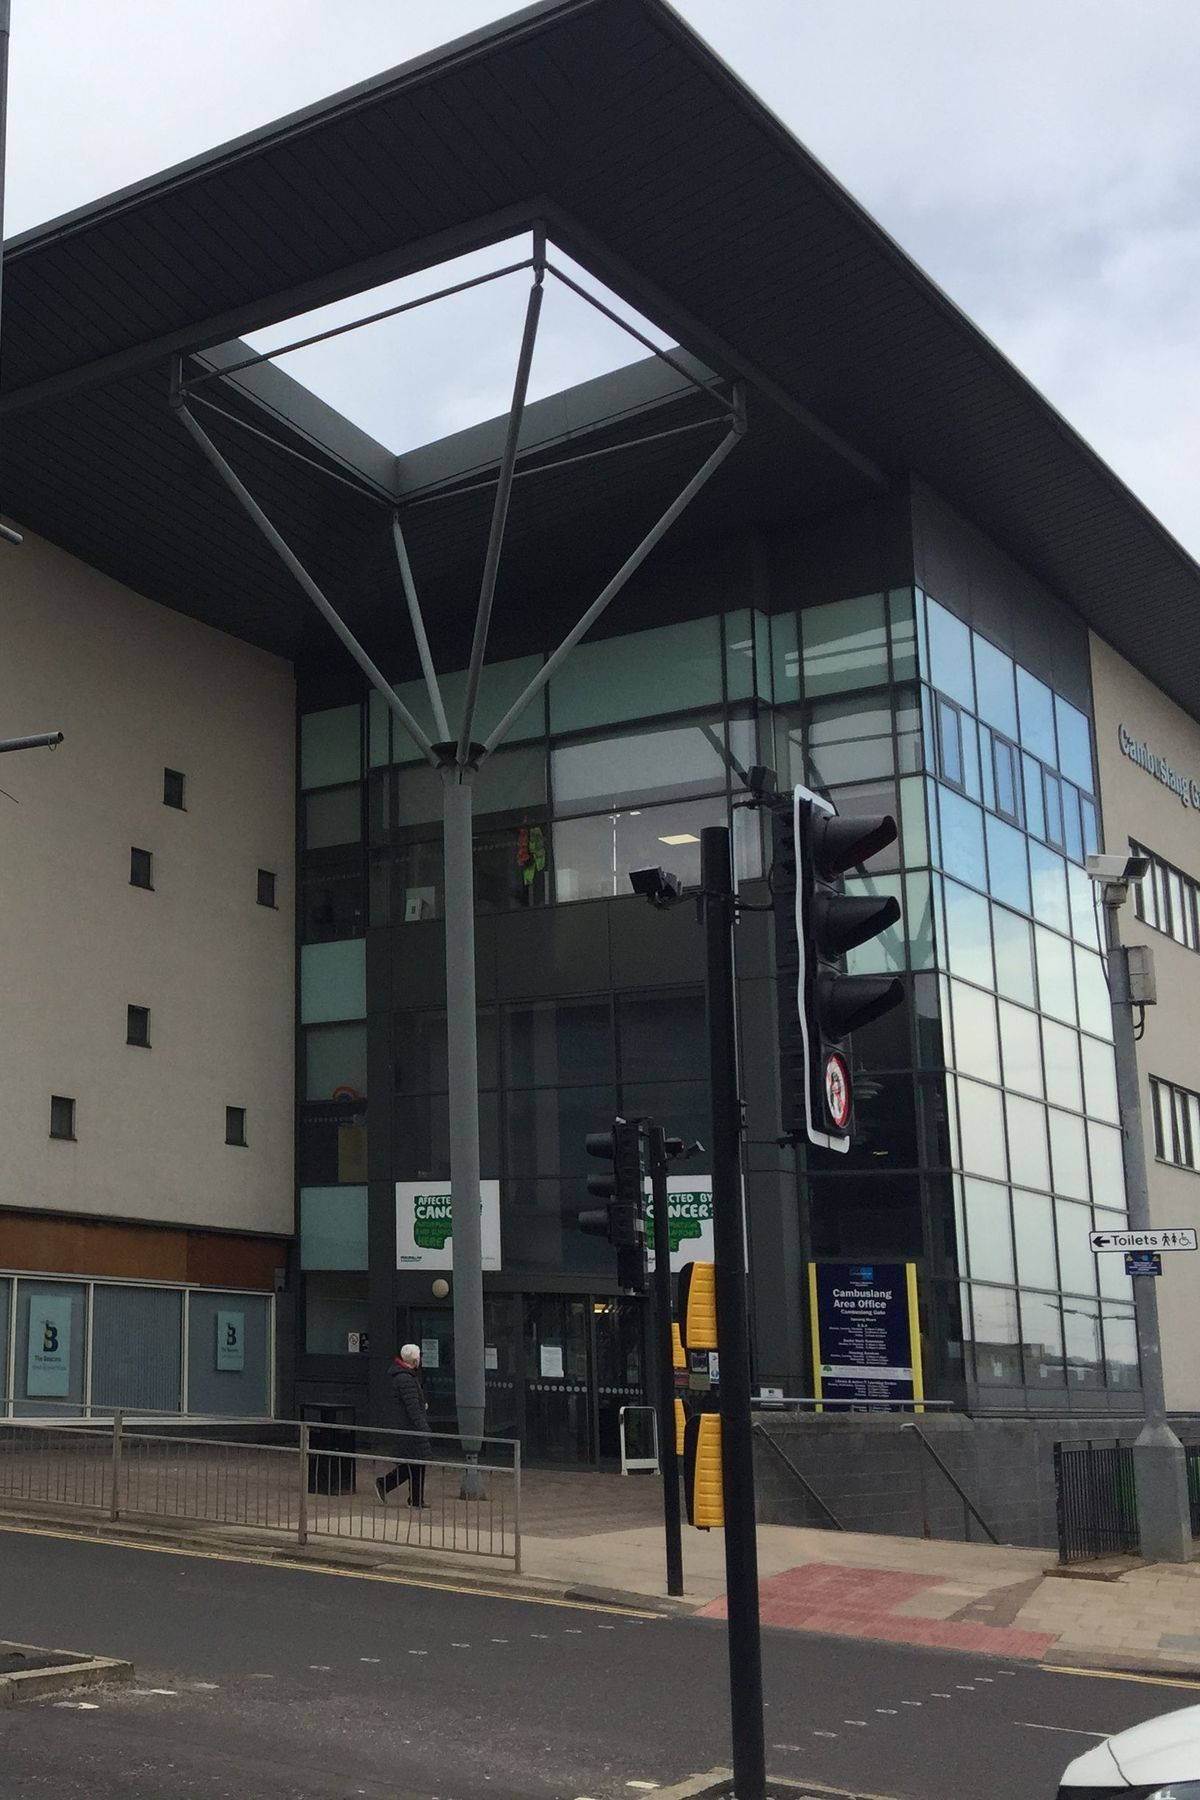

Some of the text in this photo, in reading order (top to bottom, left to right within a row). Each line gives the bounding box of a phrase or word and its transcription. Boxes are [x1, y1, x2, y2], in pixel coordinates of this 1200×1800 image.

[418, 1196, 452, 1205] AFFECTE
[1111, 1235, 1157, 1246] Toilets
[833, 1289, 892, 1300] Cambuslang
[833, 1299, 887, 1309] Area Office
